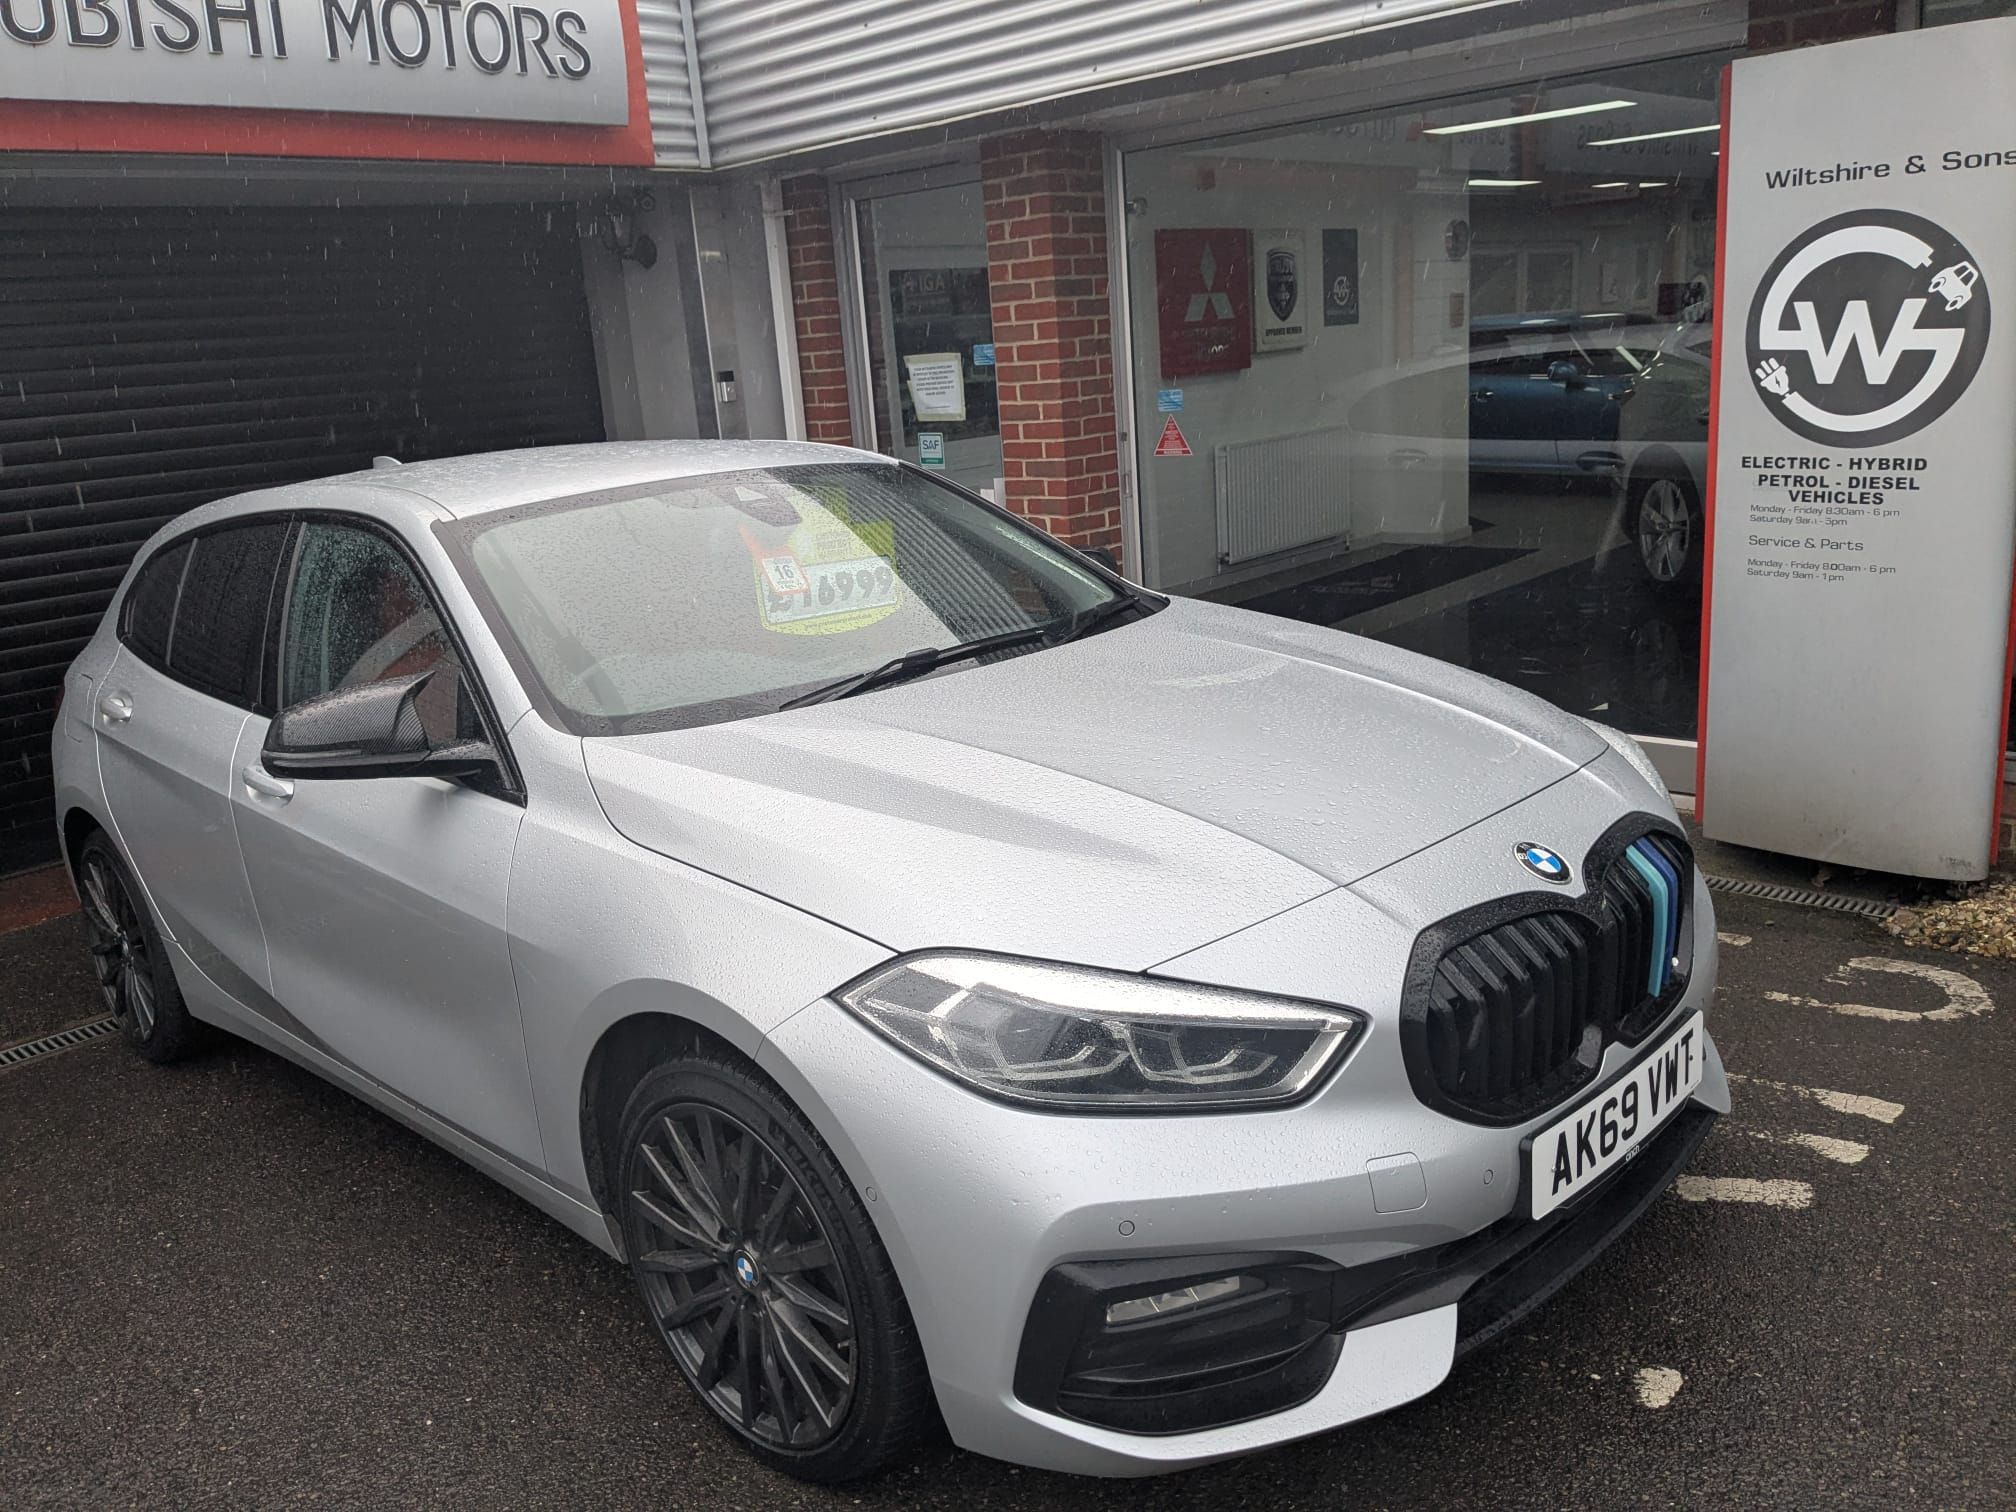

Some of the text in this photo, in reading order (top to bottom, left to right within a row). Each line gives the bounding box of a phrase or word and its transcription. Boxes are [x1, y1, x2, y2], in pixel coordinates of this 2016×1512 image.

[321, 0, 592, 80] MOTORS
[1765, 150, 2016, 189] Wiltshire & Sons
[1741, 456, 1831, 470] ELECTRIC
[1849, 457, 1928, 471] HYBRID
[1758, 474, 1830, 488] PETROL
[1847, 476, 1920, 491] DIESEL
[1788, 490, 1884, 505] VEHICLES
[1750, 504, 1786, 515] Monday
[1793, 505, 1823, 516] Friday
[1825, 506, 1865, 516] 8.30am
[1883, 509, 1901, 518] pm
[1749, 514, 1793, 525] Saturday
[1748, 535, 1864, 551] Service & Parts
[774, 564, 794, 580] 16
[1747, 559, 1783, 570] Monday
[1790, 561, 1820, 572] Friday
[1879, 566, 1896, 575] pm
[1747, 568, 1790, 580] Saturday
[1792, 571, 1814, 580] 9am
[1551, 1027, 1694, 1197] AK69 VWT
